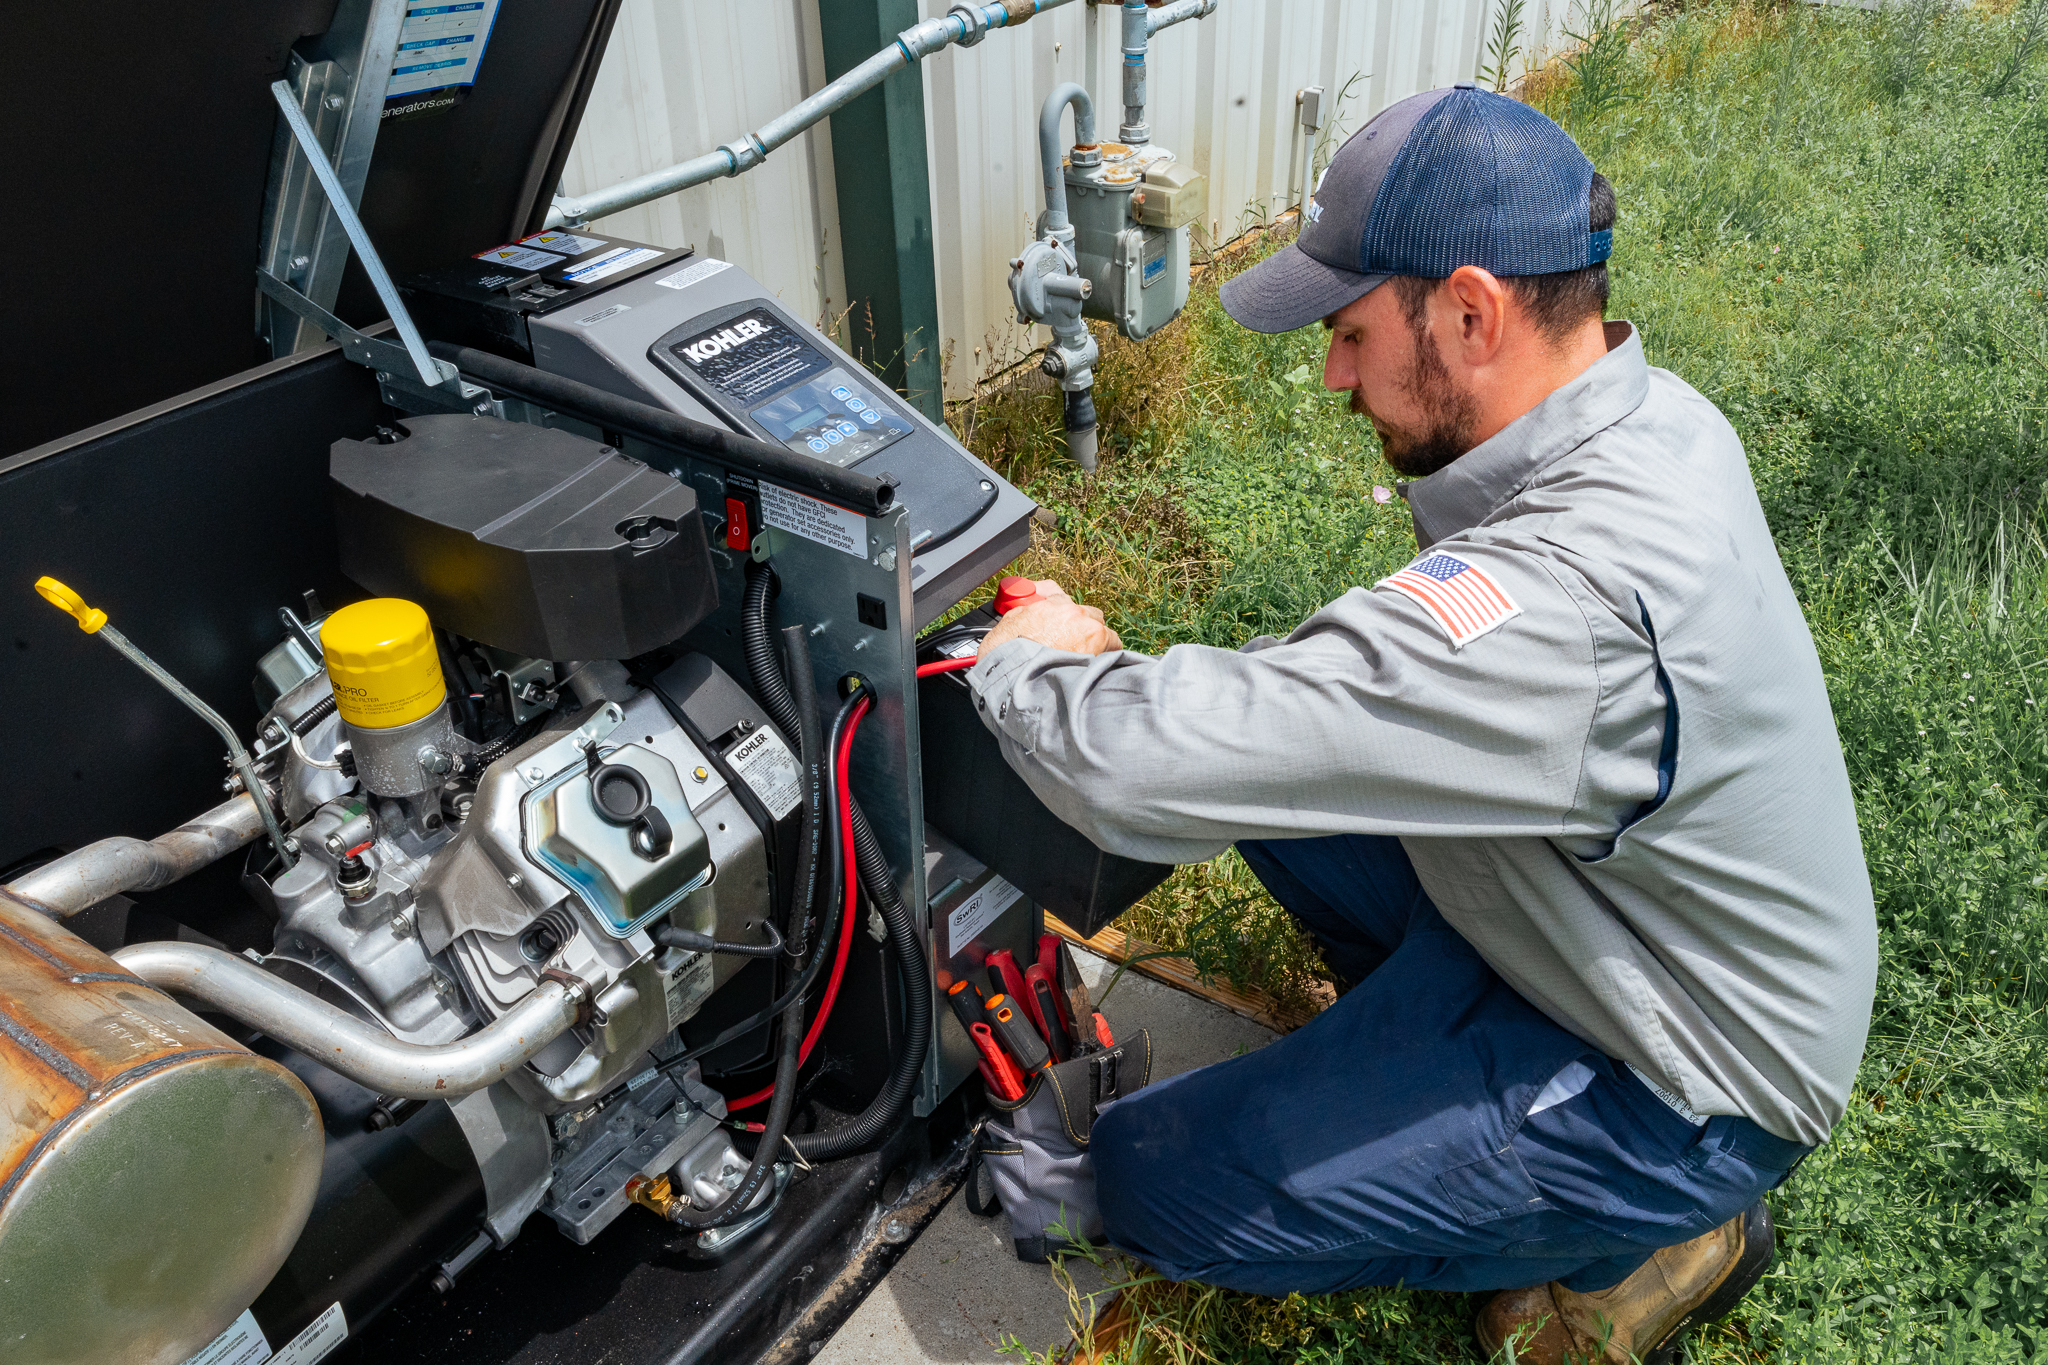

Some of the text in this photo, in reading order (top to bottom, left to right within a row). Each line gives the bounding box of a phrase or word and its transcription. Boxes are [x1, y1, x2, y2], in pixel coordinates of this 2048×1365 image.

[771, 487, 778, 495] of
[778, 489, 800, 503] electric
[800, 497, 819, 510] shock.
[820, 503, 838, 516] These
[778, 497, 787, 505] do
[787, 500, 797, 509] not
[797, 502, 812, 514] have
[769, 508, 796, 523] generator
[797, 519, 806, 527] set
[806, 521, 841, 540] accessories
[770, 515, 779, 524] not
[779, 519, 790, 528] use
[791, 522, 800, 531] for
[800, 526, 811, 537] any
[811, 530, 827, 541] other
[827, 536, 853, 551] purpose.
[791, 507, 806, 521] They
[806, 514, 816, 523] are
[816, 517, 846, 534] dedicated
[734, 733, 768, 761] KOHLER
[956, 899, 979, 924] SwRI
[671, 952, 704, 981] KOHLER
